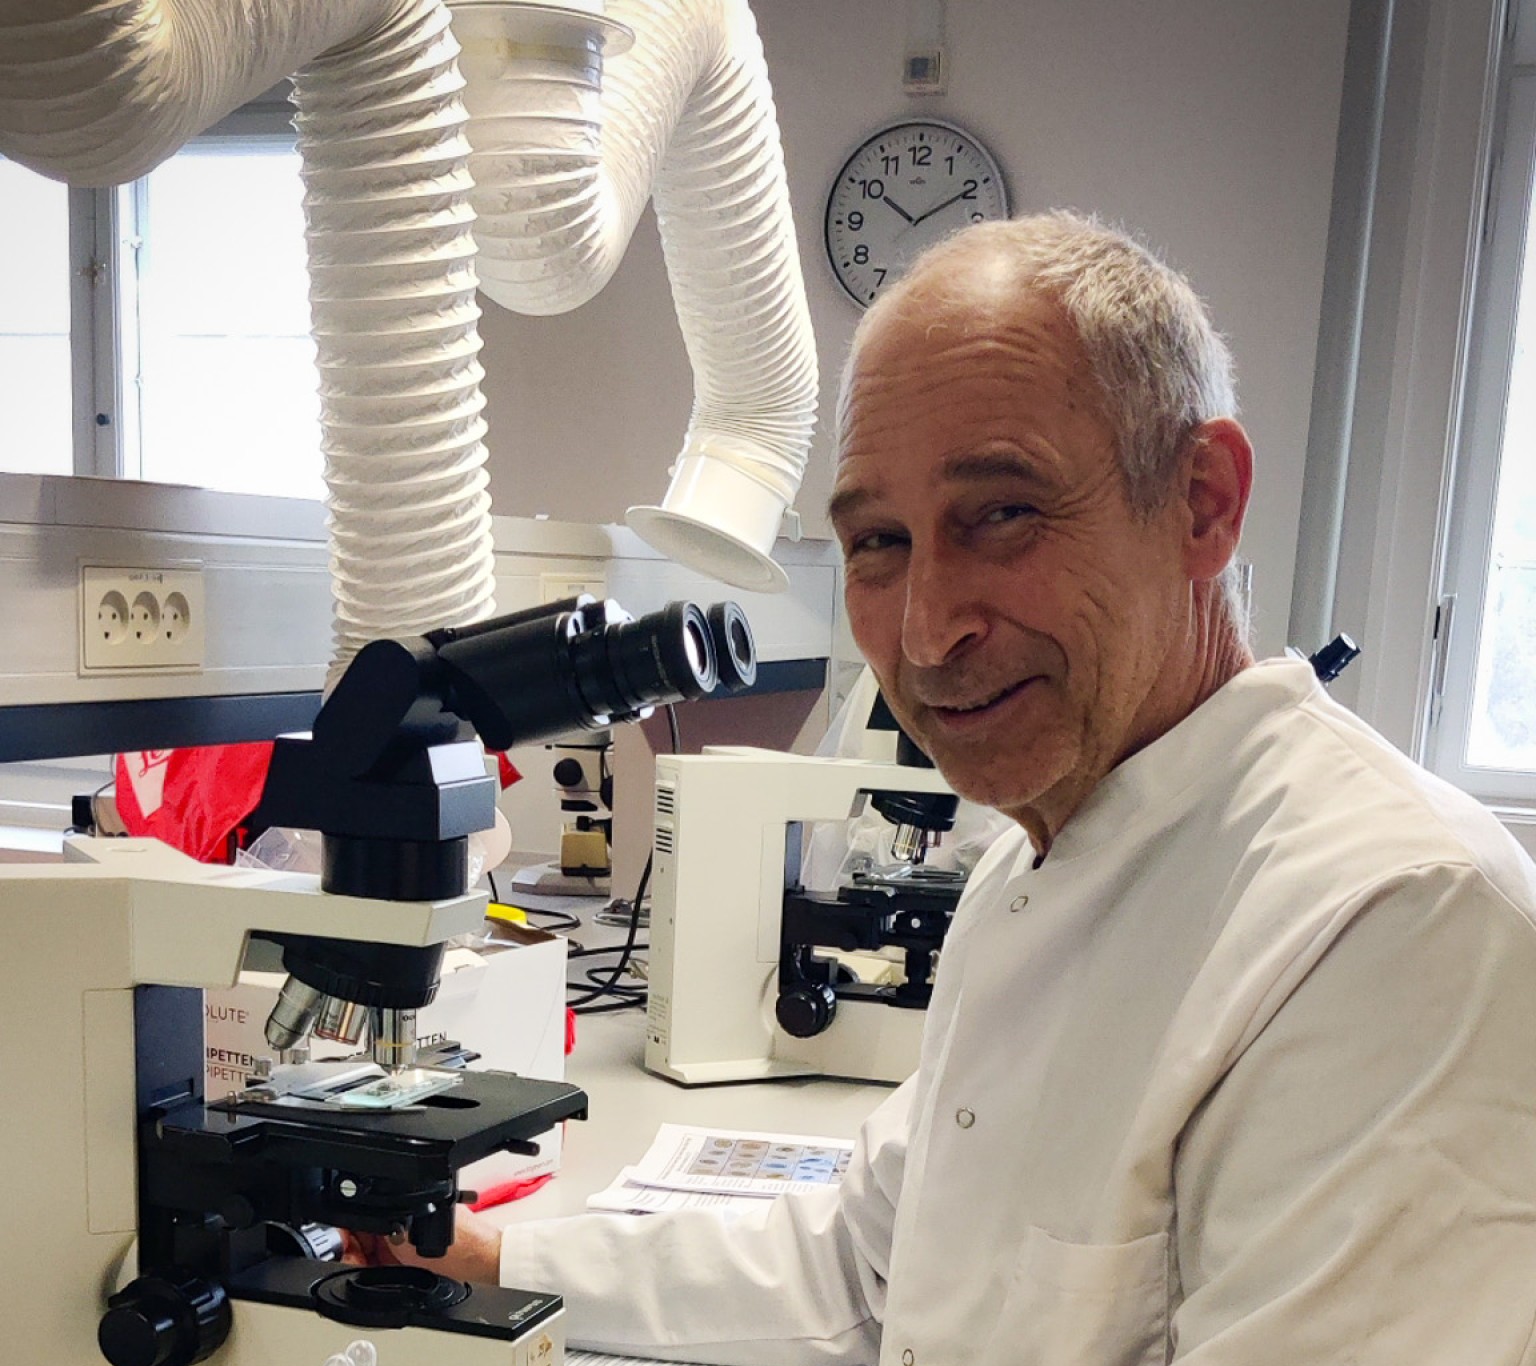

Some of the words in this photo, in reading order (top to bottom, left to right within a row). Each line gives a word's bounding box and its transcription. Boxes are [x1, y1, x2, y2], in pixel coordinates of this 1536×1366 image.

[881, 155, 899, 176] 11
[907, 145, 932, 166] 12
[944, 155, 954, 176] 1
[858, 179, 884, 199] 10
[962, 179, 978, 199] 2
[847, 211, 864, 231] 9
[853, 244, 869, 265] 8
[873, 268, 887, 288] 7
